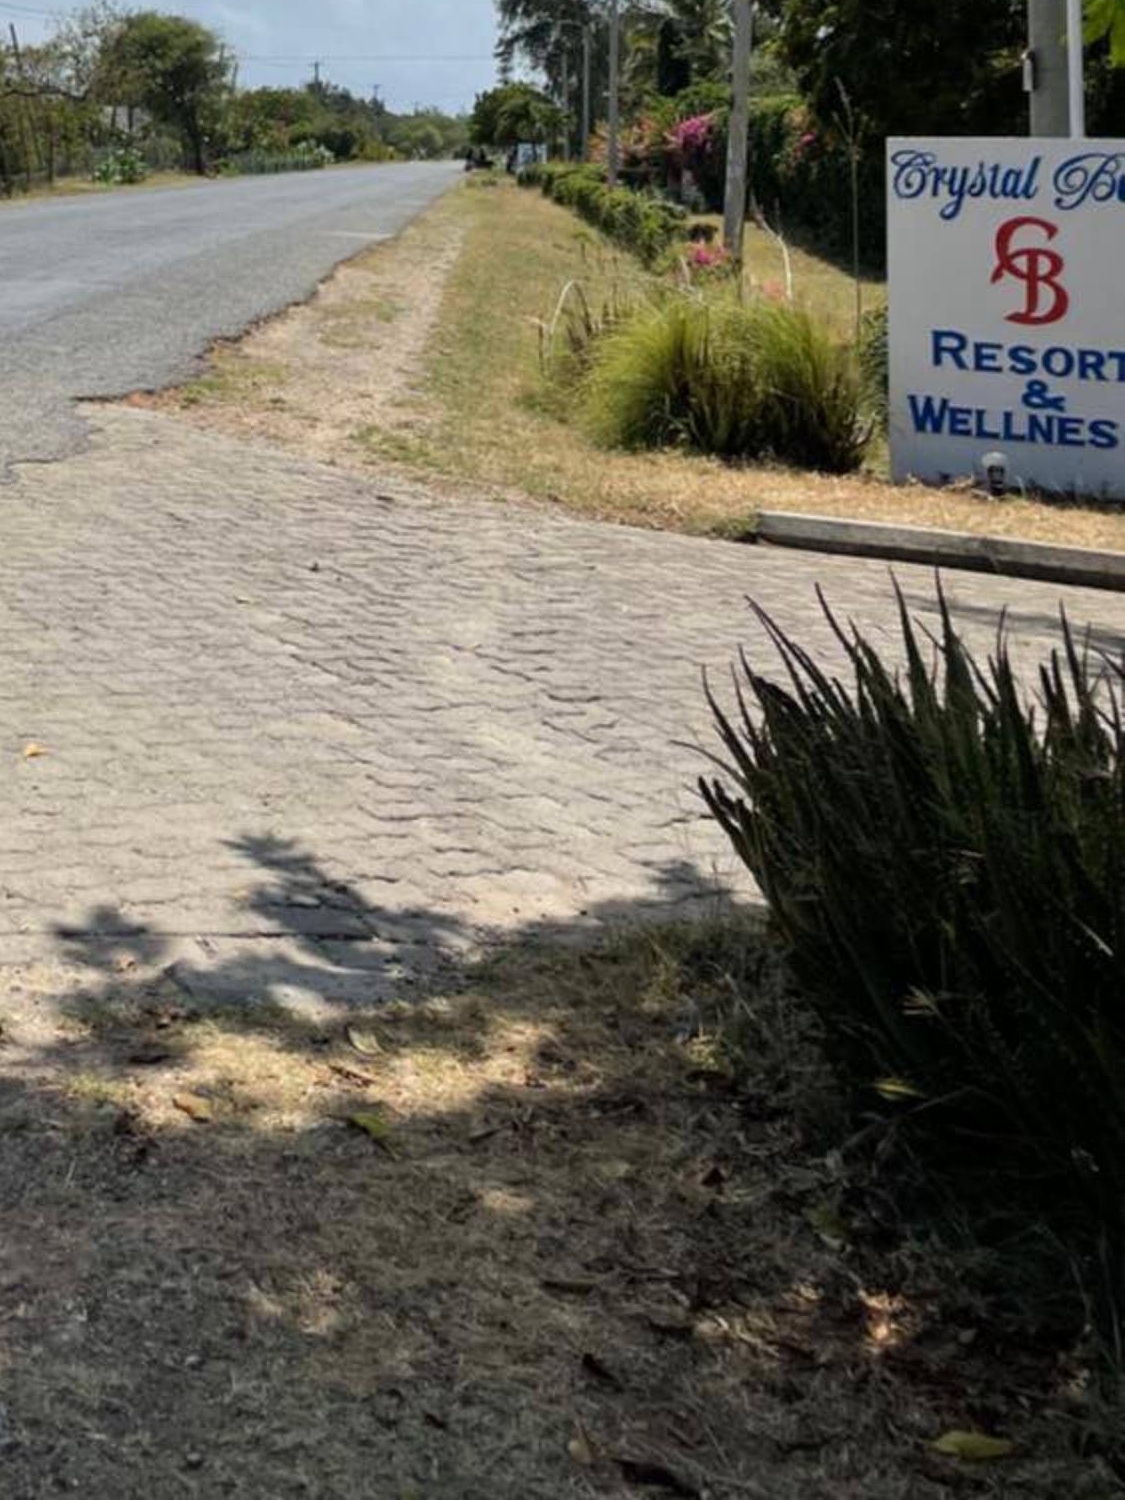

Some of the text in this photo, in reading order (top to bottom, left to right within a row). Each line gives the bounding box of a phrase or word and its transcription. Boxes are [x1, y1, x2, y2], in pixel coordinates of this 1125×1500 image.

[891, 150, 1125, 220] Crystal B
[1021, 380, 1066, 412] &
